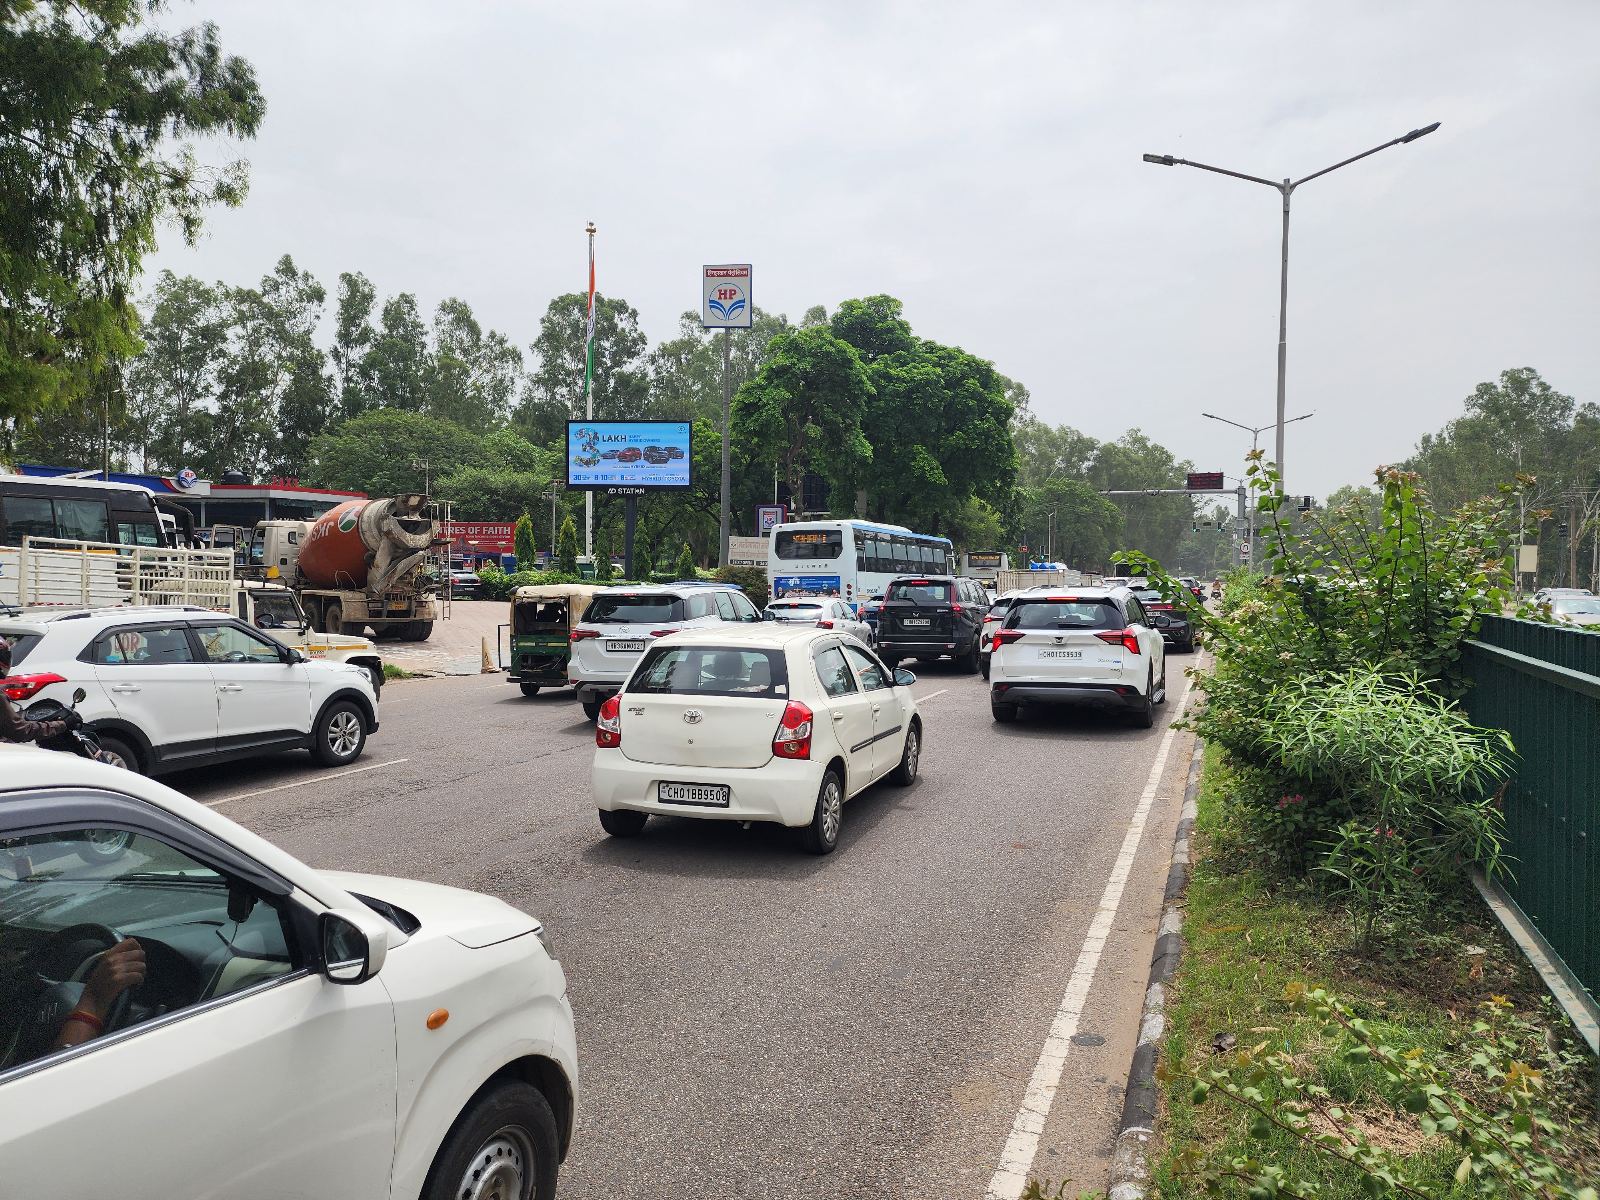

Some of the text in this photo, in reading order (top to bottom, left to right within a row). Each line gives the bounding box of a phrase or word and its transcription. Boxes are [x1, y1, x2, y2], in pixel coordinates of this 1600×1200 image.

[717, 289, 737, 300] HP
[602, 434, 627, 443] LAKH
[467, 526, 480, 534] OF
[482, 526, 511, 535] FAITH
[667, 787, 728, 802] CH01BB9508
